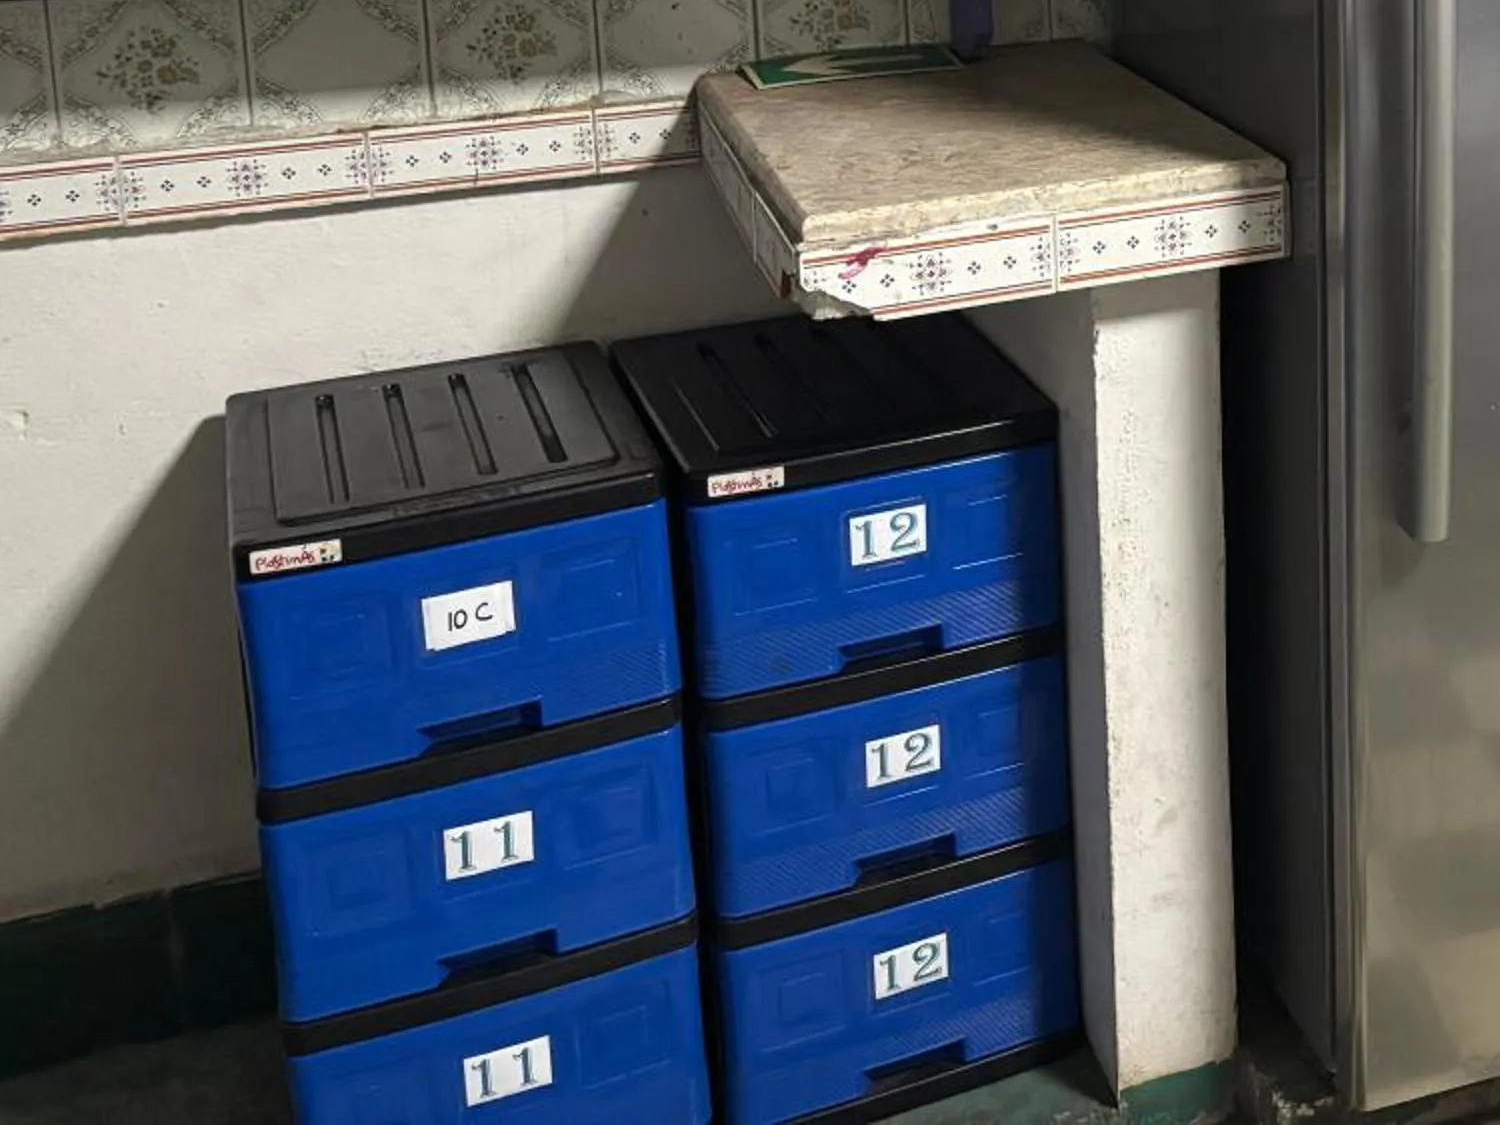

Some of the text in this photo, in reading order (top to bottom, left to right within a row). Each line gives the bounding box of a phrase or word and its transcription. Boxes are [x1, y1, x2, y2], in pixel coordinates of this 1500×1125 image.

[855, 513, 920, 559] 12
[448, 602, 493, 632] 10 C
[871, 731, 934, 782] 12
[450, 819, 518, 873] 11
[880, 941, 943, 992] 12
[472, 1045, 536, 1098] 11
